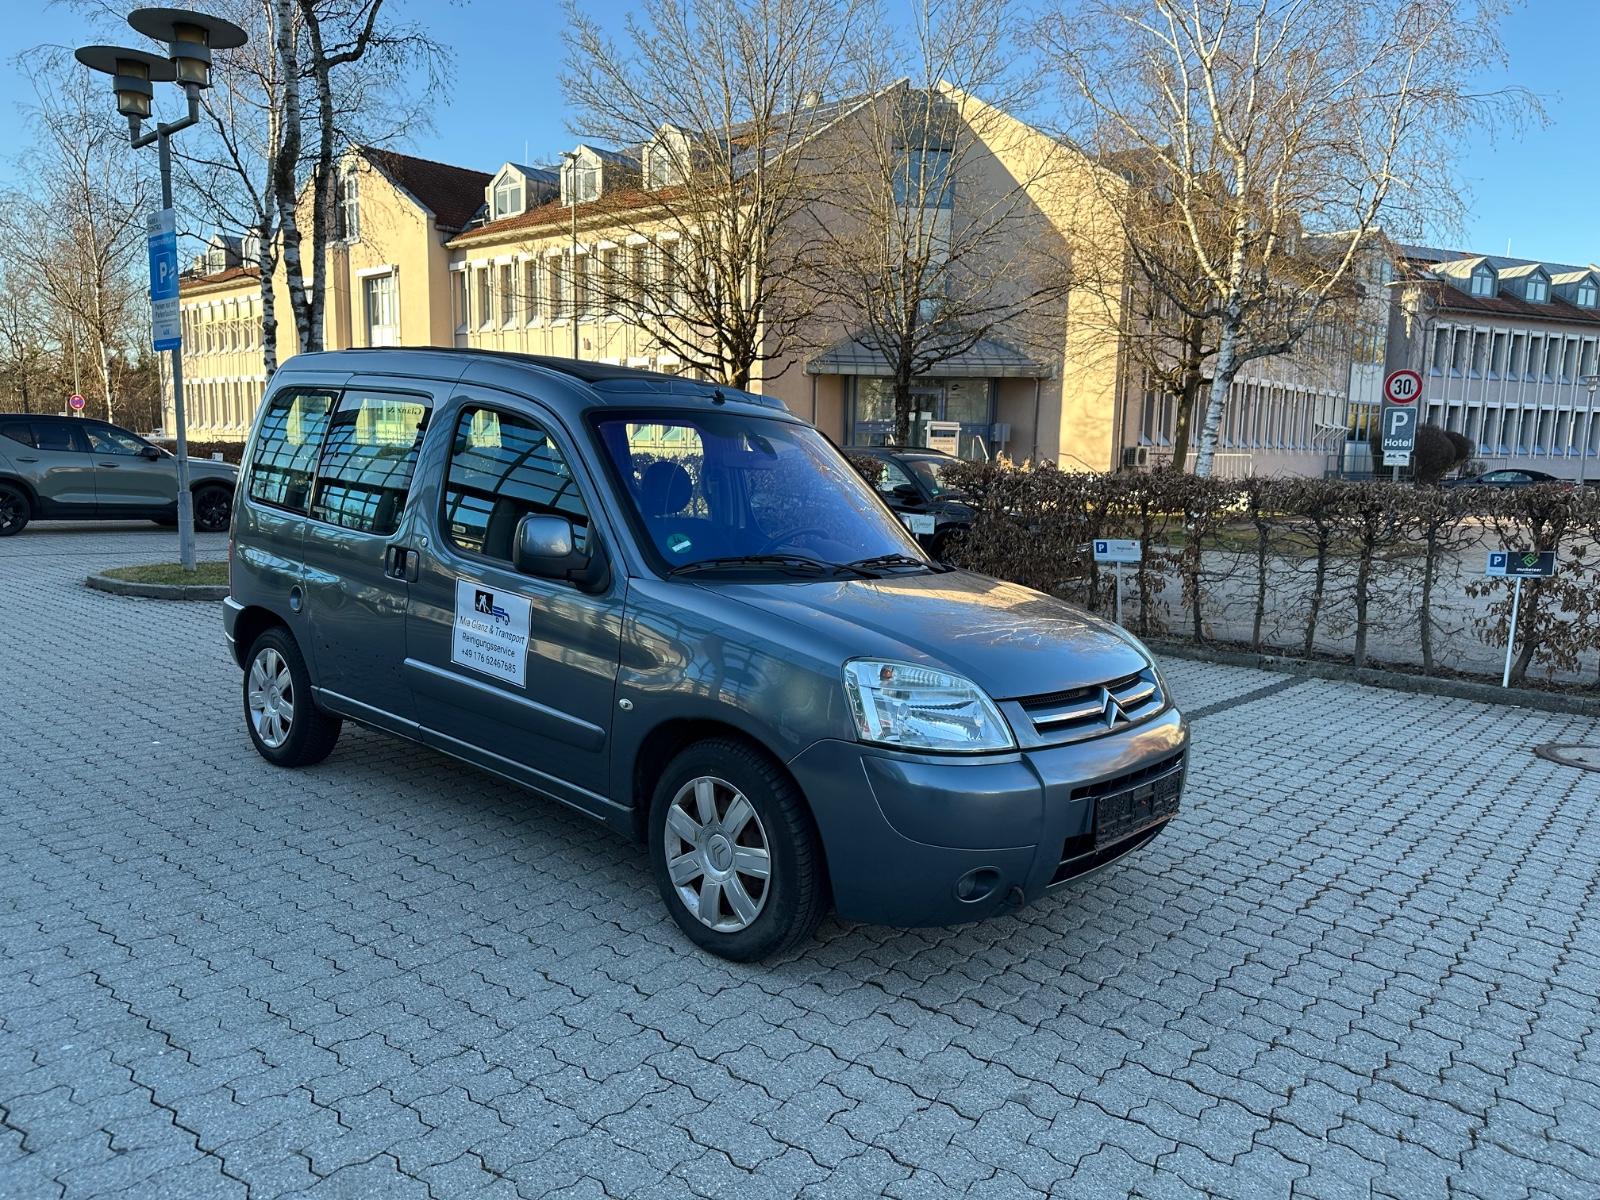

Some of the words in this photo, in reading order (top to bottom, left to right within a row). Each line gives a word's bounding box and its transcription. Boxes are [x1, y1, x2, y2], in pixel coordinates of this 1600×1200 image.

[160, 262, 167, 284] P
[1391, 411, 1408, 435] P
[1384, 438, 1412, 447] Hotel
[1098, 543, 1105, 552] P
[1493, 556, 1502, 565] P
[460, 616, 471, 626] Mia
[471, 619, 488, 633] Glanz
[489, 625, 494, 634] &
[495, 626, 525, 645] Transport
[462, 632, 516, 658] Reinigungsservice
[461, 649, 472, 658] +49
[474, 652, 485, 663] 176
